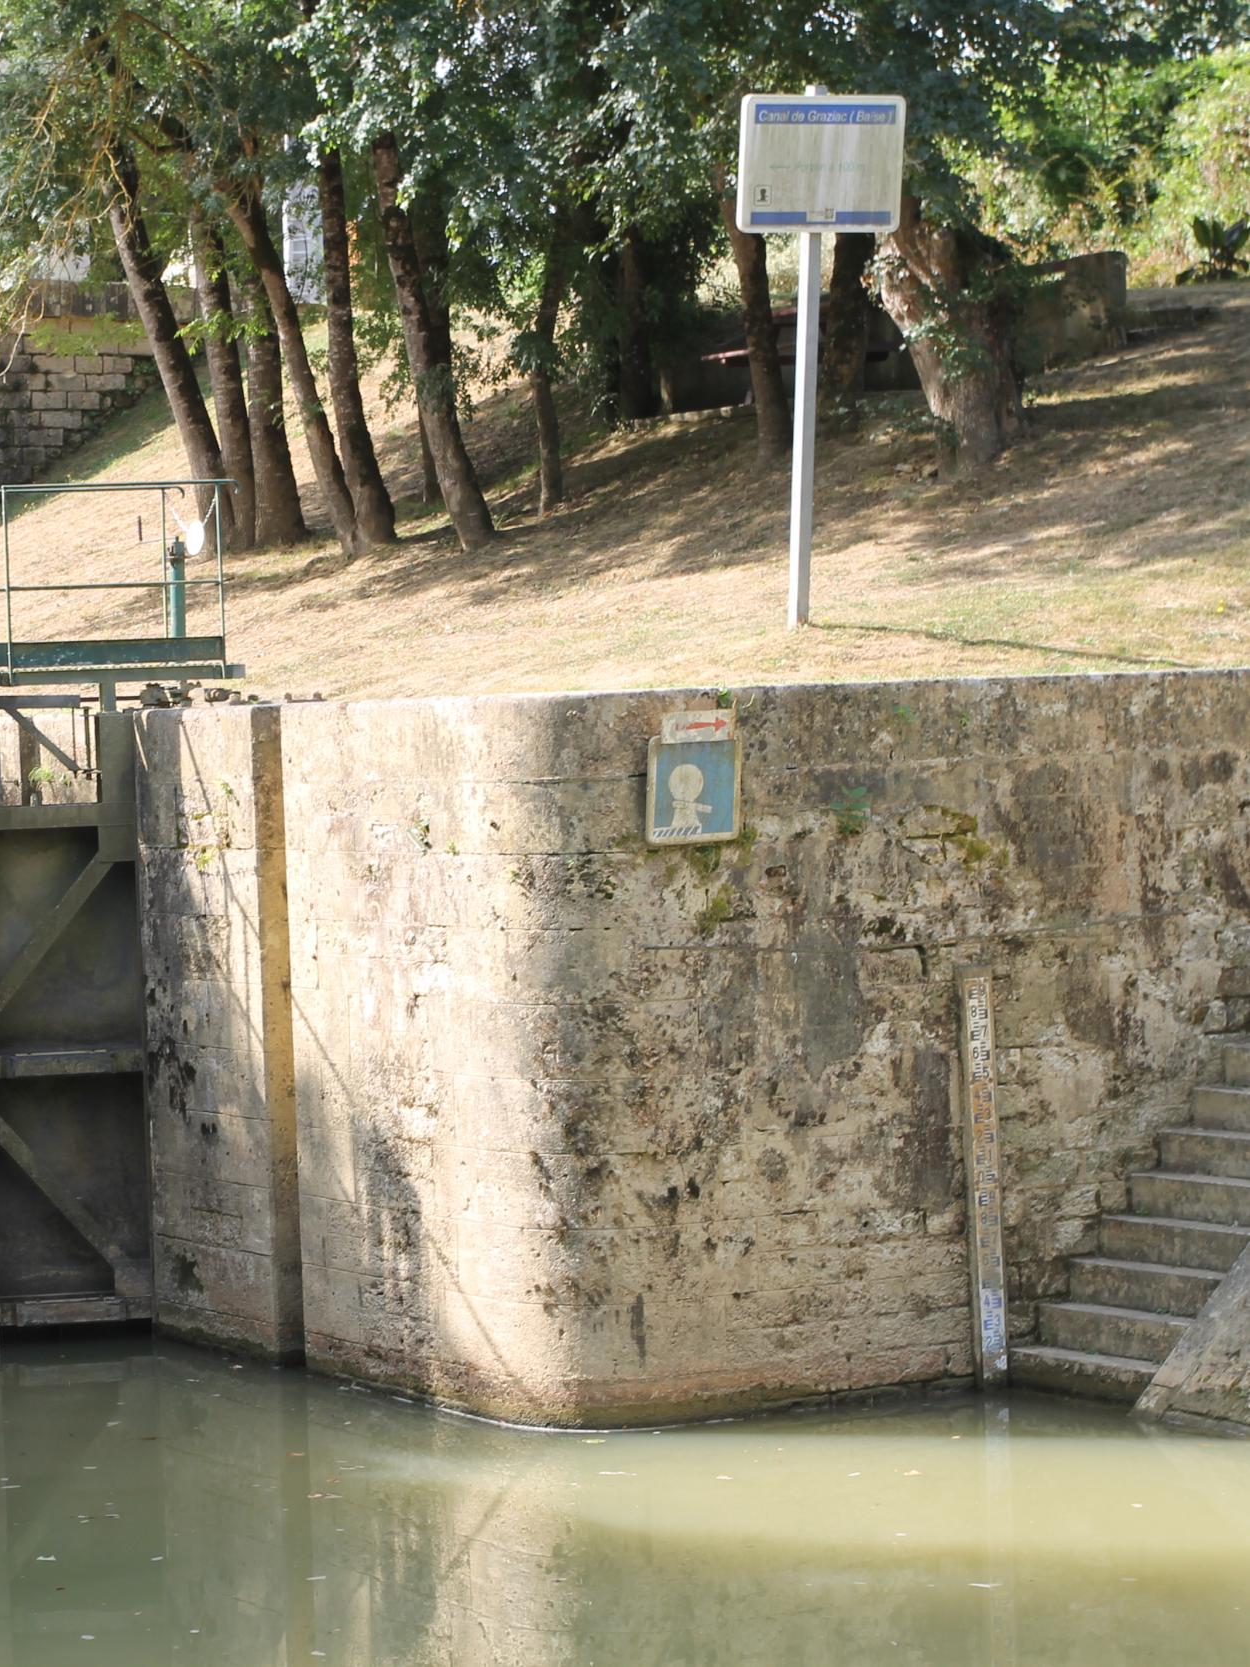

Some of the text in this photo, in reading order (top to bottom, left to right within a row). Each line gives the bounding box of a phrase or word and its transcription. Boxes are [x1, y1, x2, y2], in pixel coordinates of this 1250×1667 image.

[758, 109, 790, 122] Canal
[791, 110, 805, 122] de
[807, 109, 847, 122] Graziac
[971, 1005, 977, 1018] 8
[981, 1024, 988, 1038] 7
[972, 1046, 979, 1060] 6
[982, 1066, 990, 1079] 5
[983, 1295, 990, 1308] 4
